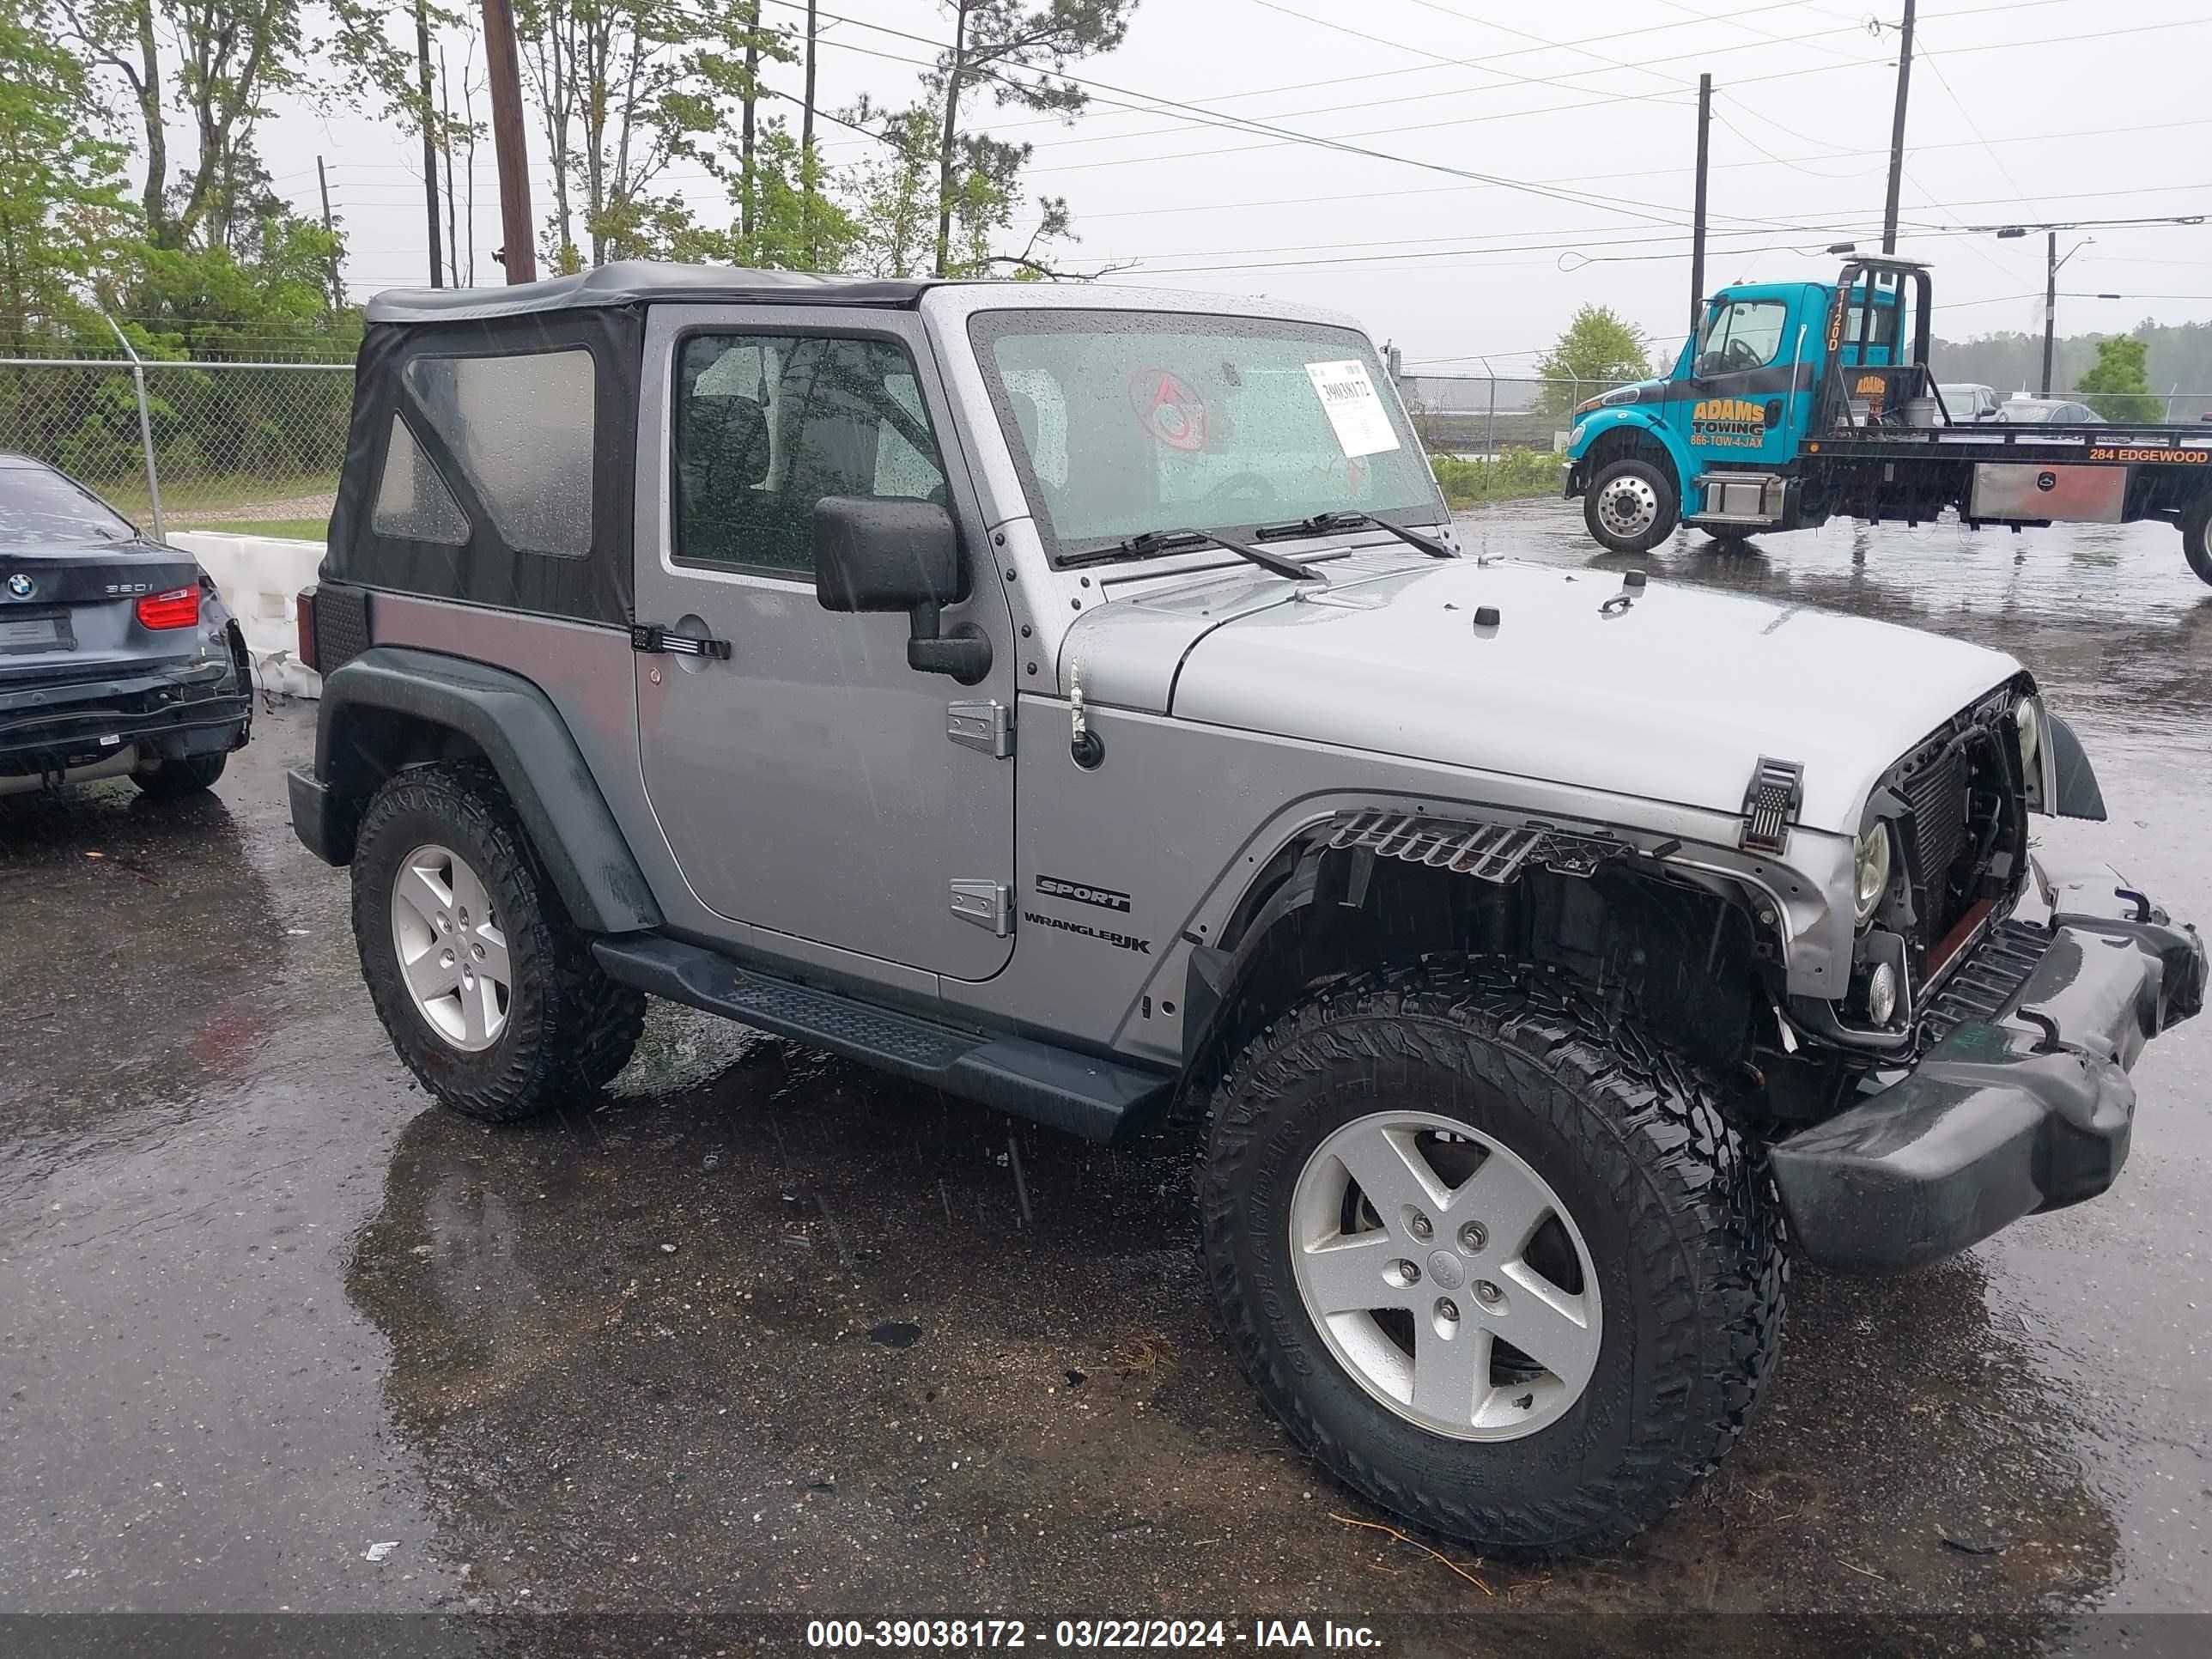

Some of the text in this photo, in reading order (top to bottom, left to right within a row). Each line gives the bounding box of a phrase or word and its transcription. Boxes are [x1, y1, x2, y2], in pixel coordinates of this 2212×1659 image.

[1828, 289, 1845, 351] 1120D
[1322, 380, 1370, 402] 39038172
[1856, 375, 1886, 393] ADAMS
[1692, 398, 1765, 422] ADAMS
[1691, 421, 1765, 436] TOWING
[1690, 434, 1763, 448] 866-TOW-4-JAX
[2088, 448, 2209, 463] 284 EDGEWOOD
[1036, 878, 1130, 908] SPORT
